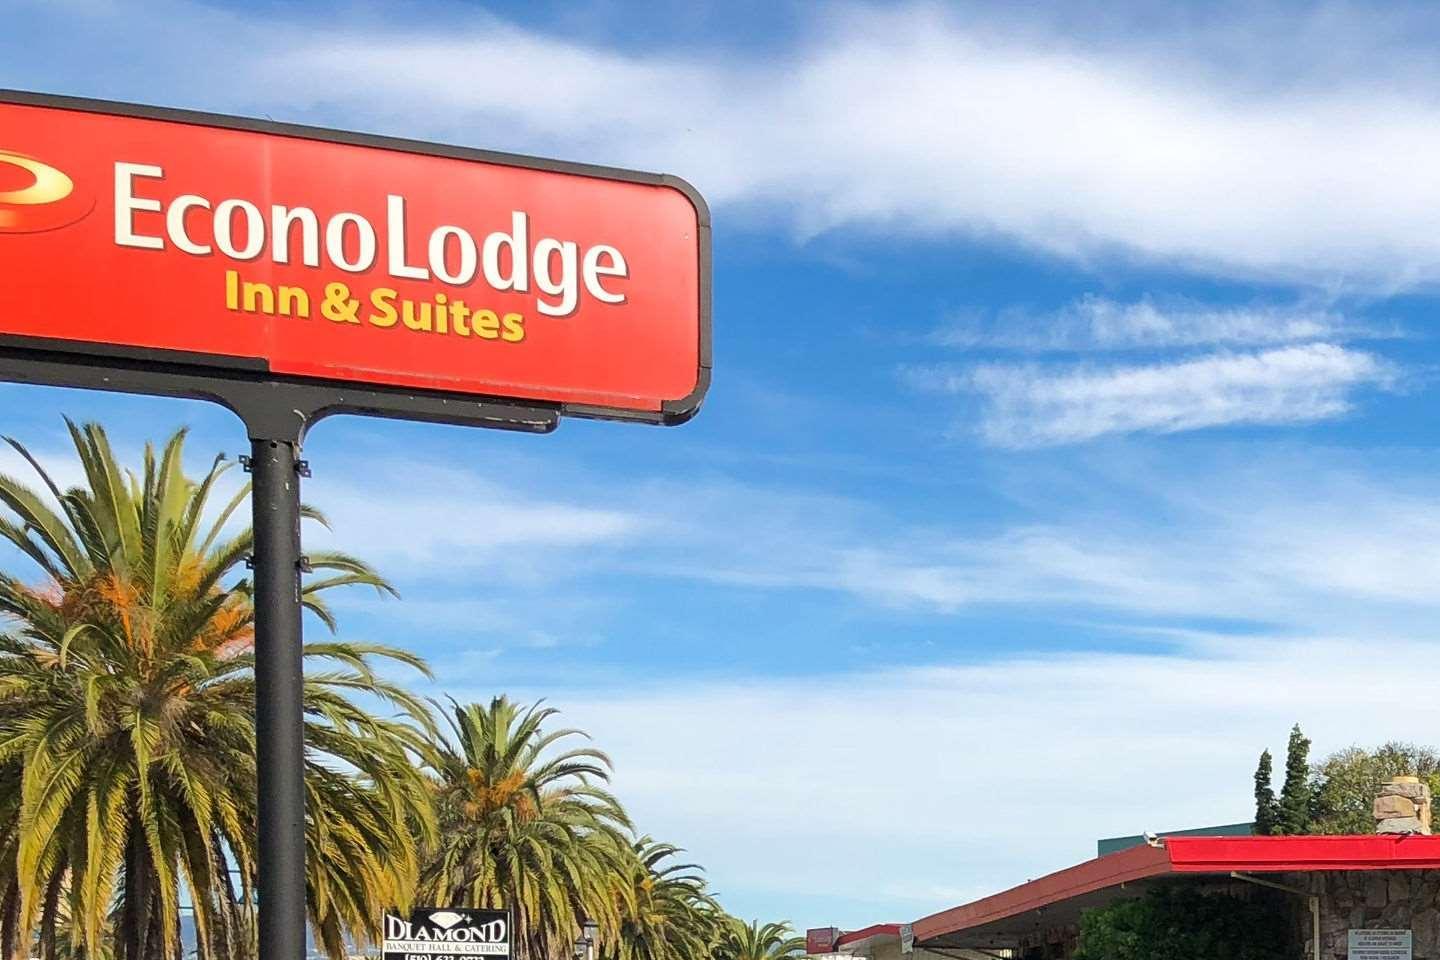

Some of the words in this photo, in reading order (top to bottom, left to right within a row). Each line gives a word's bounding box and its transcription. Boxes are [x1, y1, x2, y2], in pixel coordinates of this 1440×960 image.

[114, 161, 628, 316] EconoLodge
[225, 270, 310, 318] Inn
[321, 281, 361, 325] &
[368, 286, 526, 343] Suites
[386, 914, 506, 943] DIAMOND
[386, 943, 426, 952] BANQUET
[428, 943, 452, 952] HALL
[454, 944, 462, 952] &
[464, 944, 507, 953] CATERING
